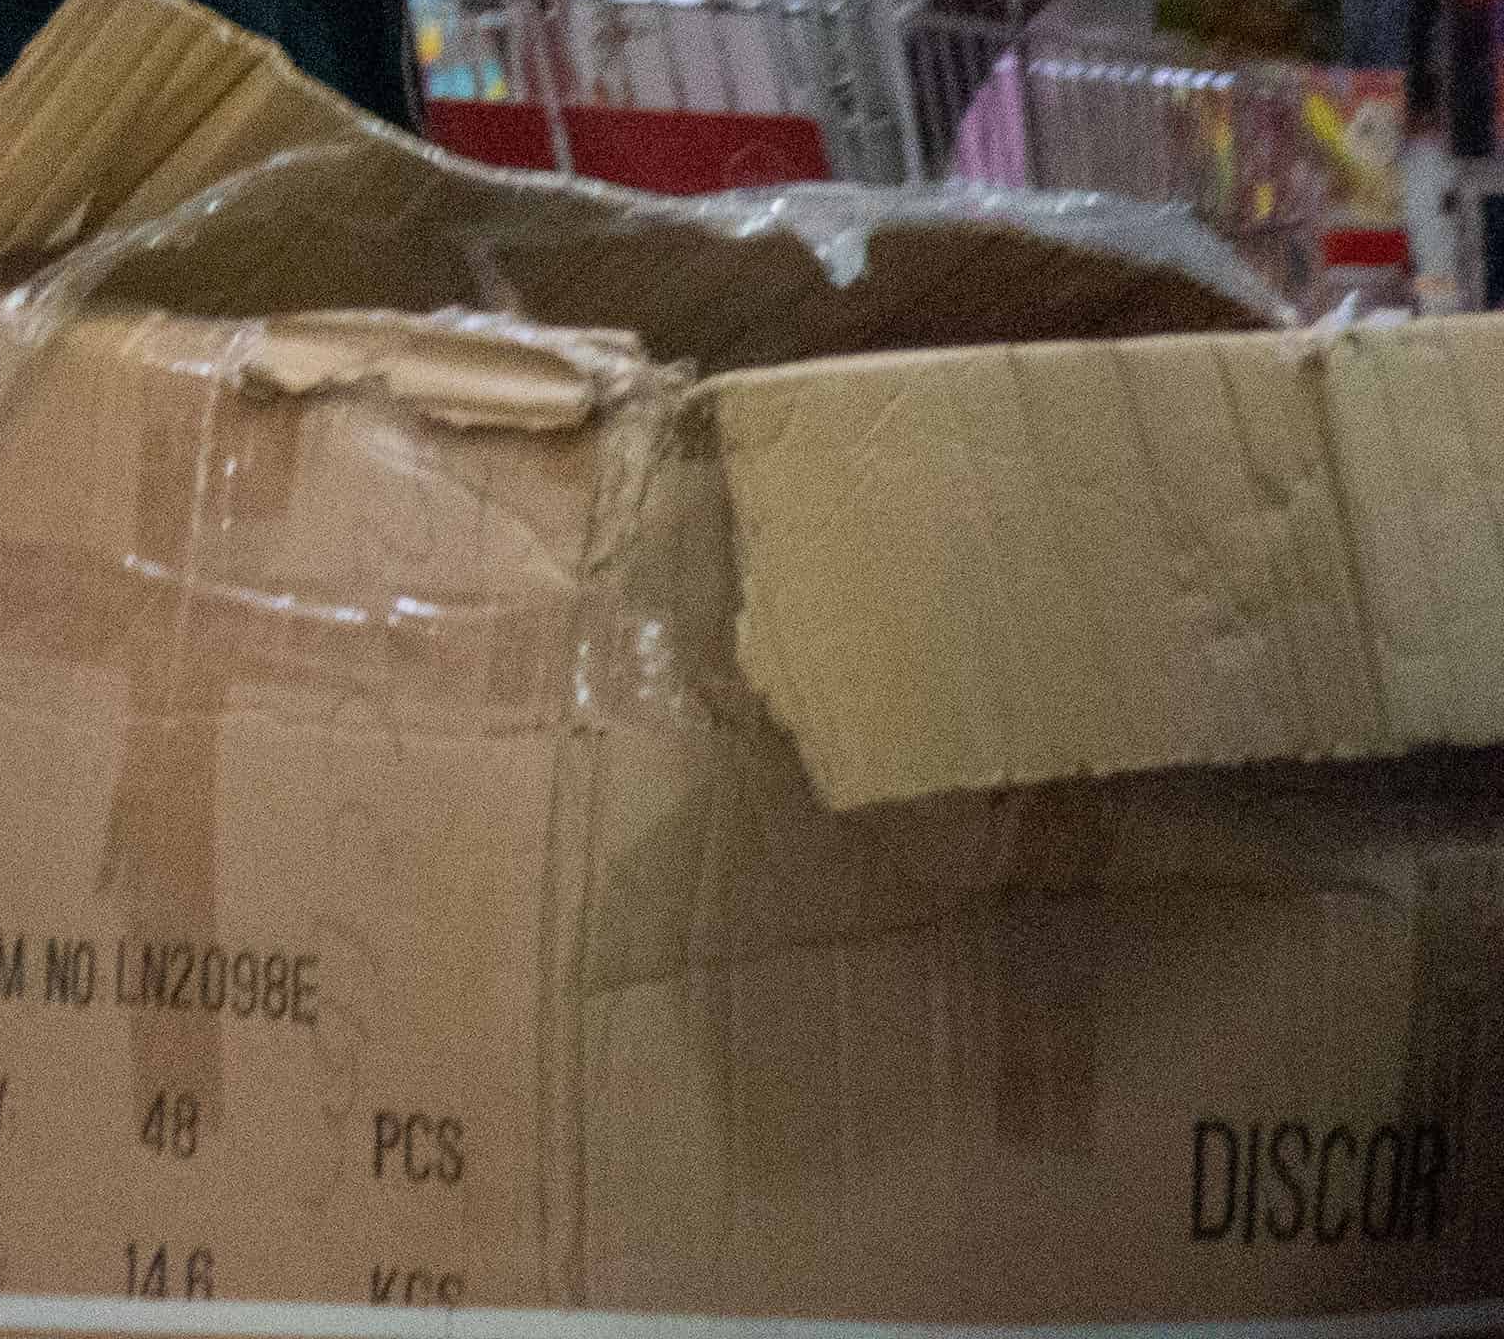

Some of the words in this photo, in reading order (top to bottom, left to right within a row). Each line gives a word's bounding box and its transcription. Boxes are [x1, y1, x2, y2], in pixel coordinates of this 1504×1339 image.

[45, 937, 96, 1006] NO
[115, 940, 320, 1024] LN2098E
[142, 1091, 201, 1158] 48
[374, 1112, 465, 1184] PCS
